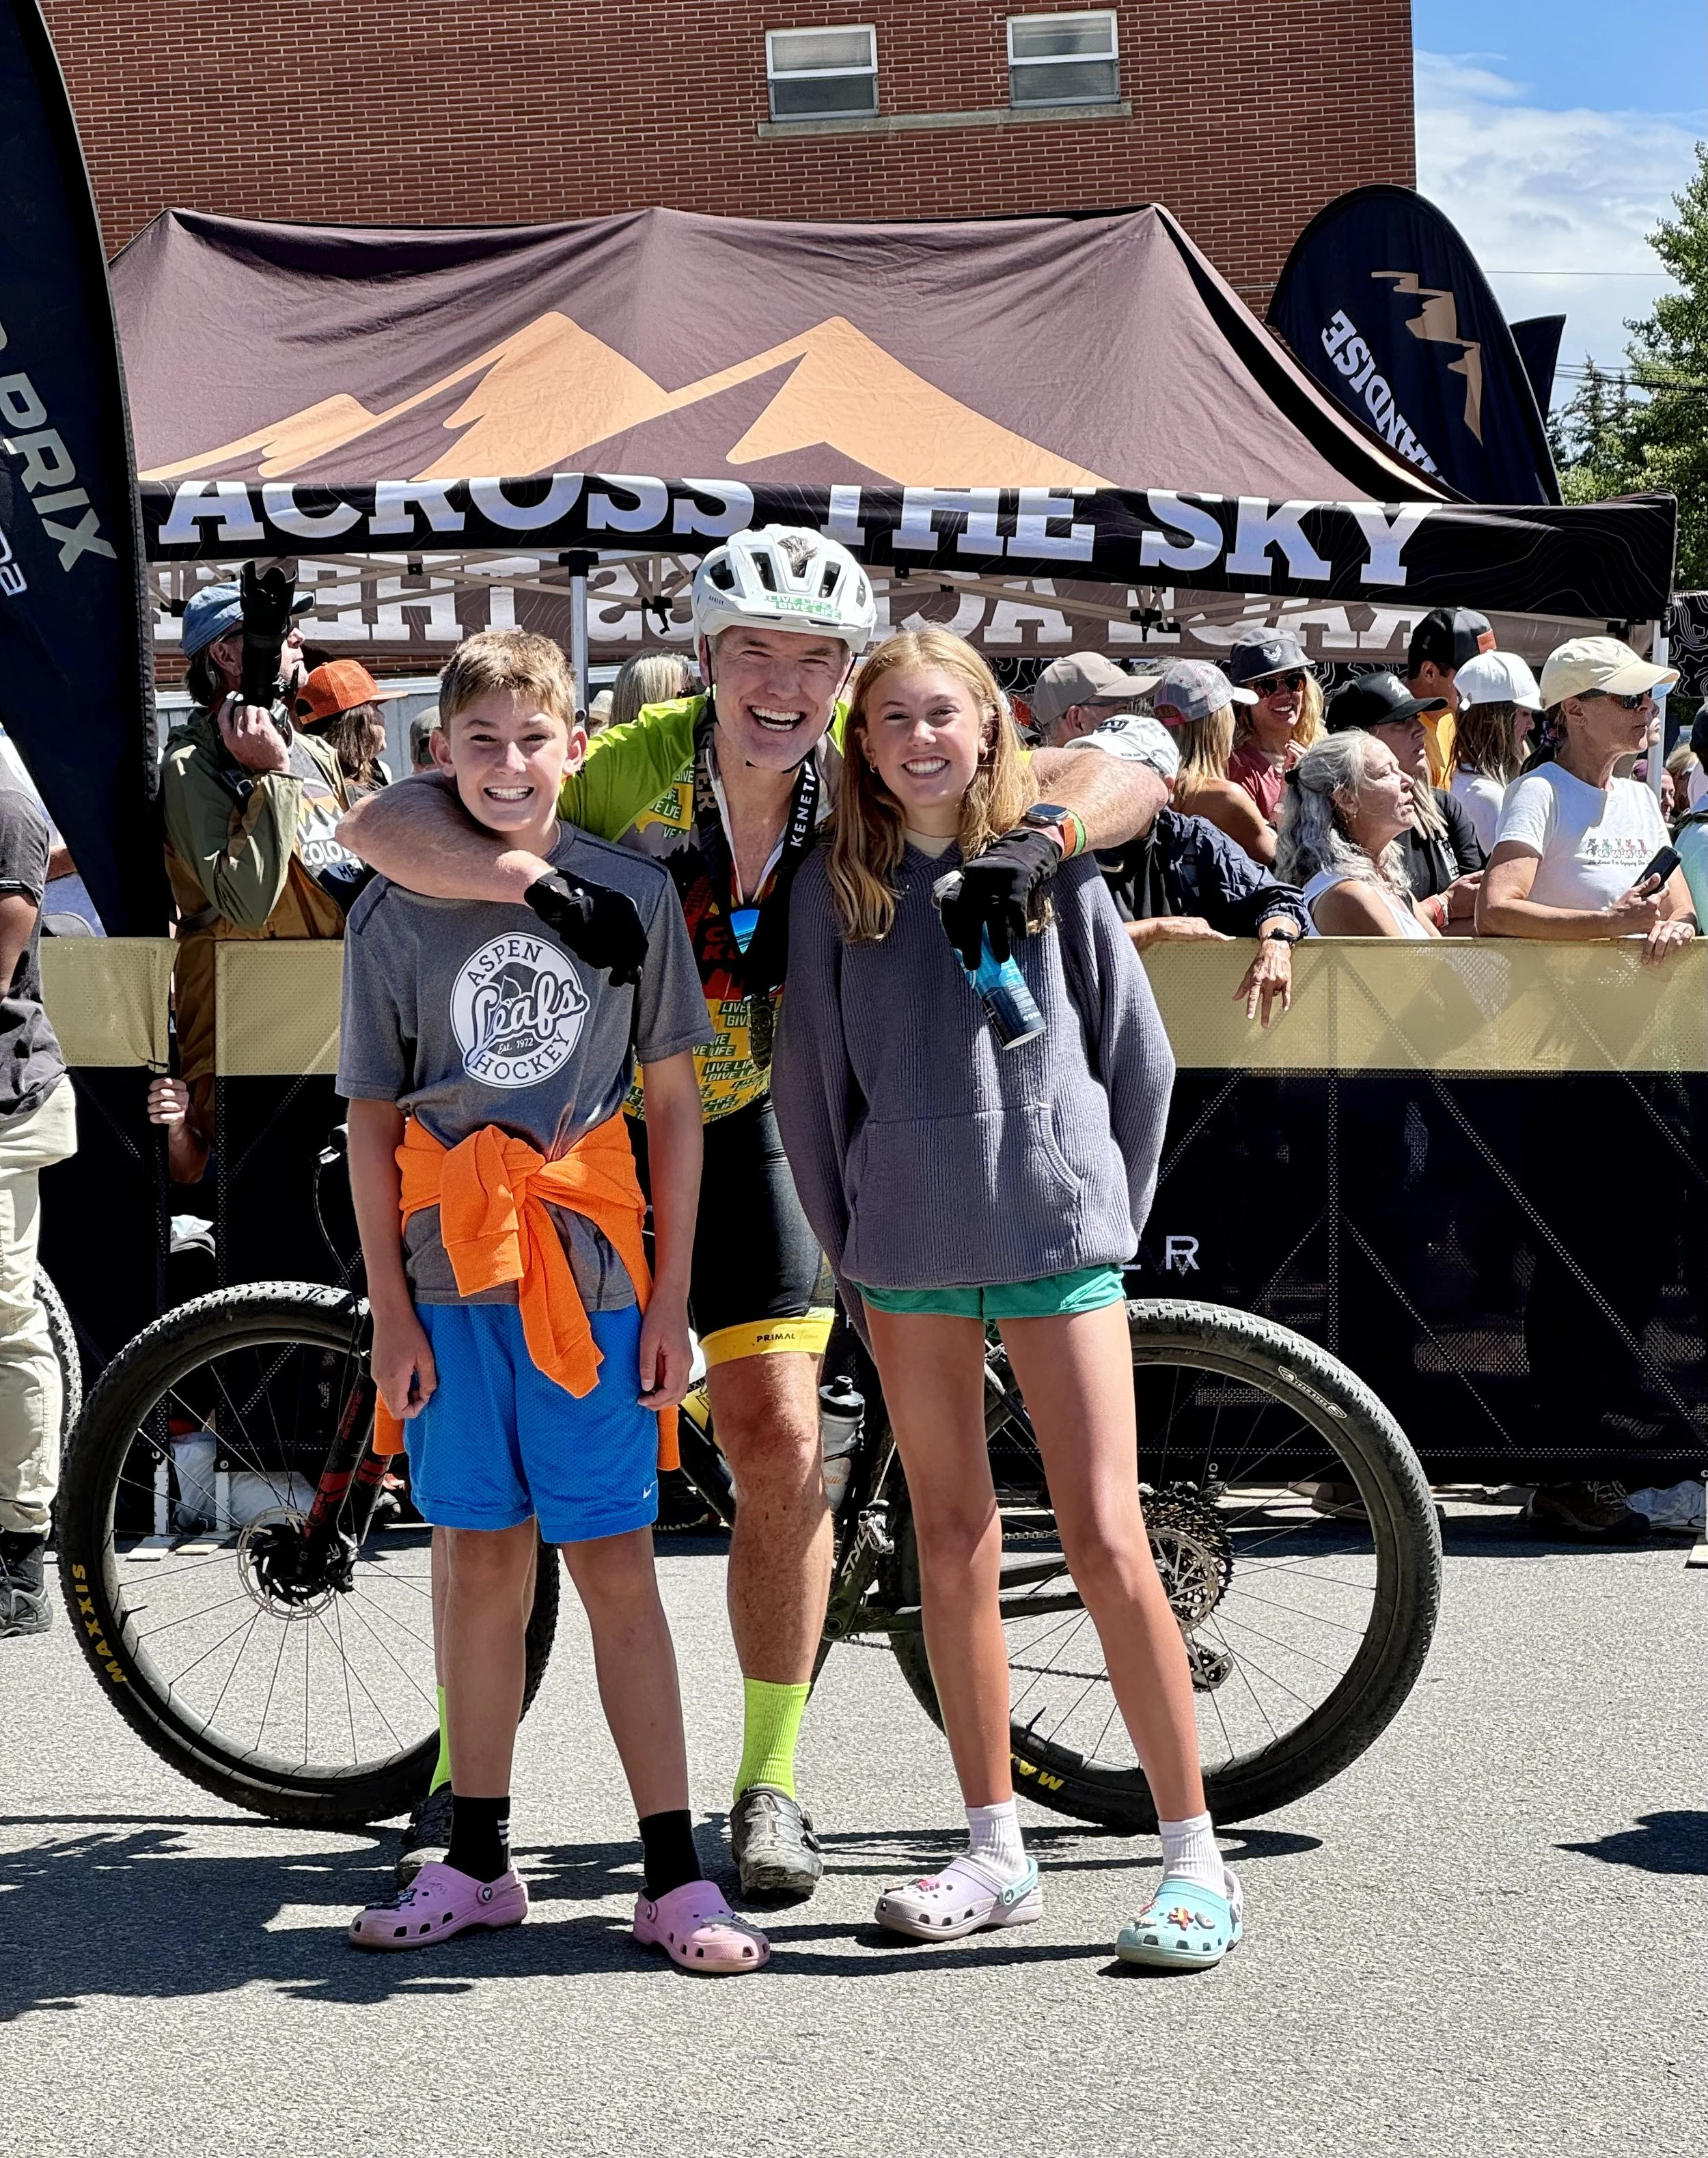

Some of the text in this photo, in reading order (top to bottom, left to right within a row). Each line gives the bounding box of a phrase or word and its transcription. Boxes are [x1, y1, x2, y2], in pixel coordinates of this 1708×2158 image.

[1321, 309, 1442, 478] ANDISE
[0, 372, 118, 572] PRIX
[159, 472, 755, 544] ACROSS
[1140, 488, 1443, 586] SKY
[769, 596, 831, 609] LIVE LIFE
[778, 602, 842, 620] GIVE LIFE
[467, 940, 543, 986] ASPEN
[465, 971, 589, 1067] Leafs
[721, 1001, 747, 1013] LIVE
[726, 1014, 749, 1026] GIV
[473, 1030, 570, 1079] HOCKEY
[497, 1038, 534, 1054] Est. 1972
[706, 1062, 731, 1073] LIVE
[708, 1071, 735, 1081] GIVE
[756, 1333, 795, 1343] PRIMAL
[840, 1525, 868, 1587] STYL
[72, 1564, 128, 1683] MAXXIS
